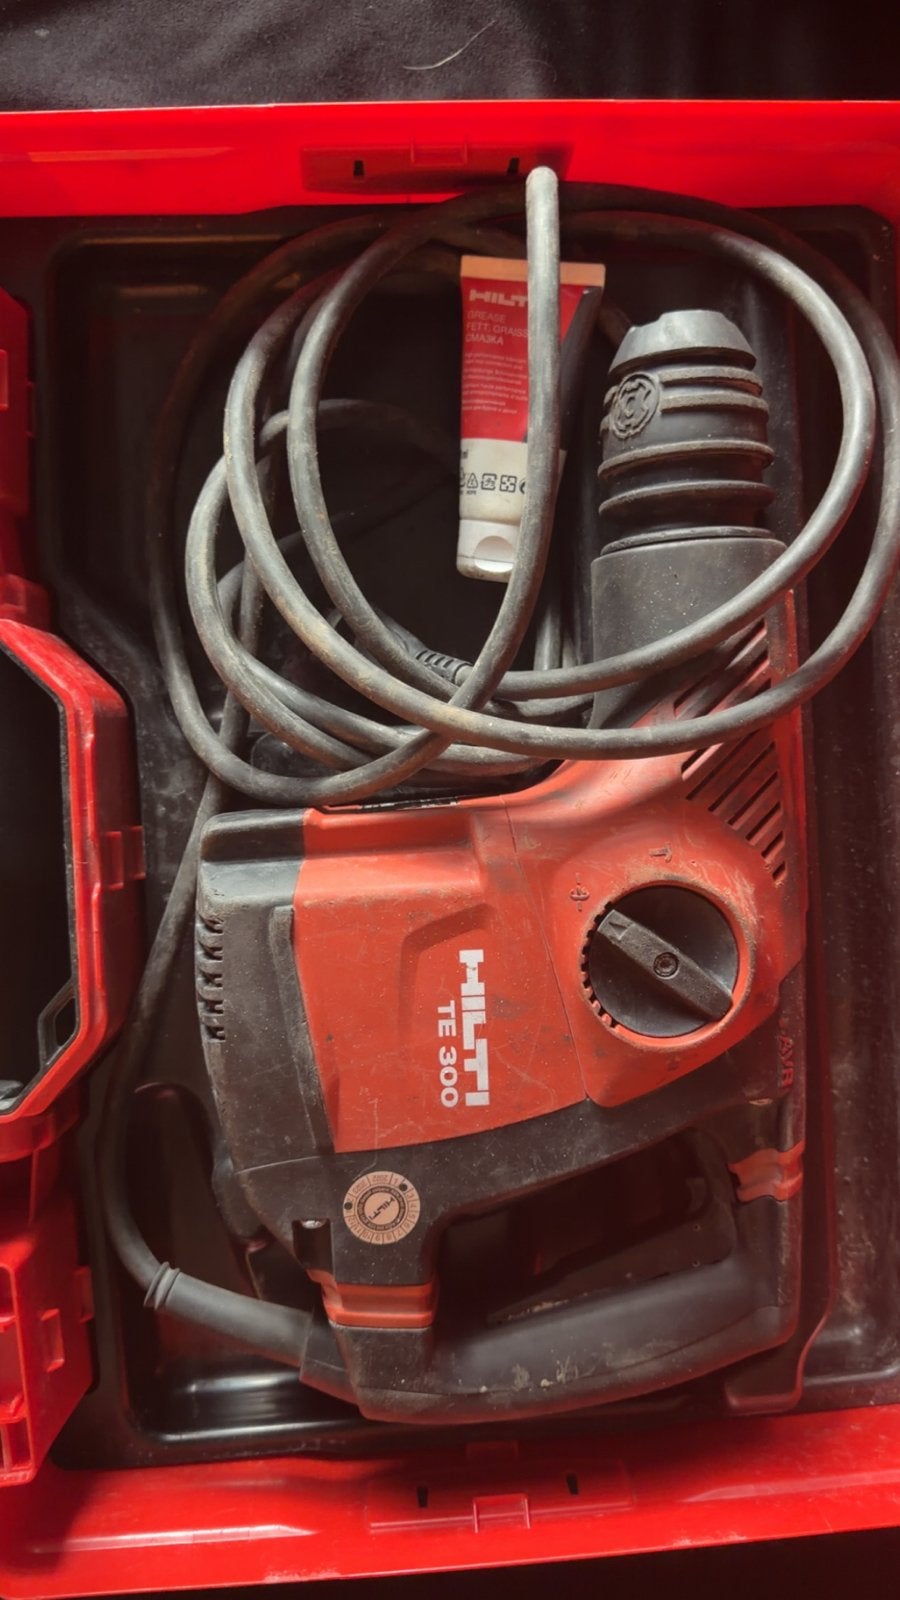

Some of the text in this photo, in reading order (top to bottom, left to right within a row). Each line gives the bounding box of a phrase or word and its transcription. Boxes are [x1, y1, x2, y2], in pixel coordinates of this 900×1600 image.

[469, 289, 528, 307] HILT
[467, 311, 506, 324] GREASE
[465, 333, 504, 346] СМАЗКА
[493, 325, 528, 338] GRAISS
[459, 949, 490, 1106] HILTI
[437, 1000, 459, 1108] TE 300
[368, 1196, 396, 1221] HILTI
